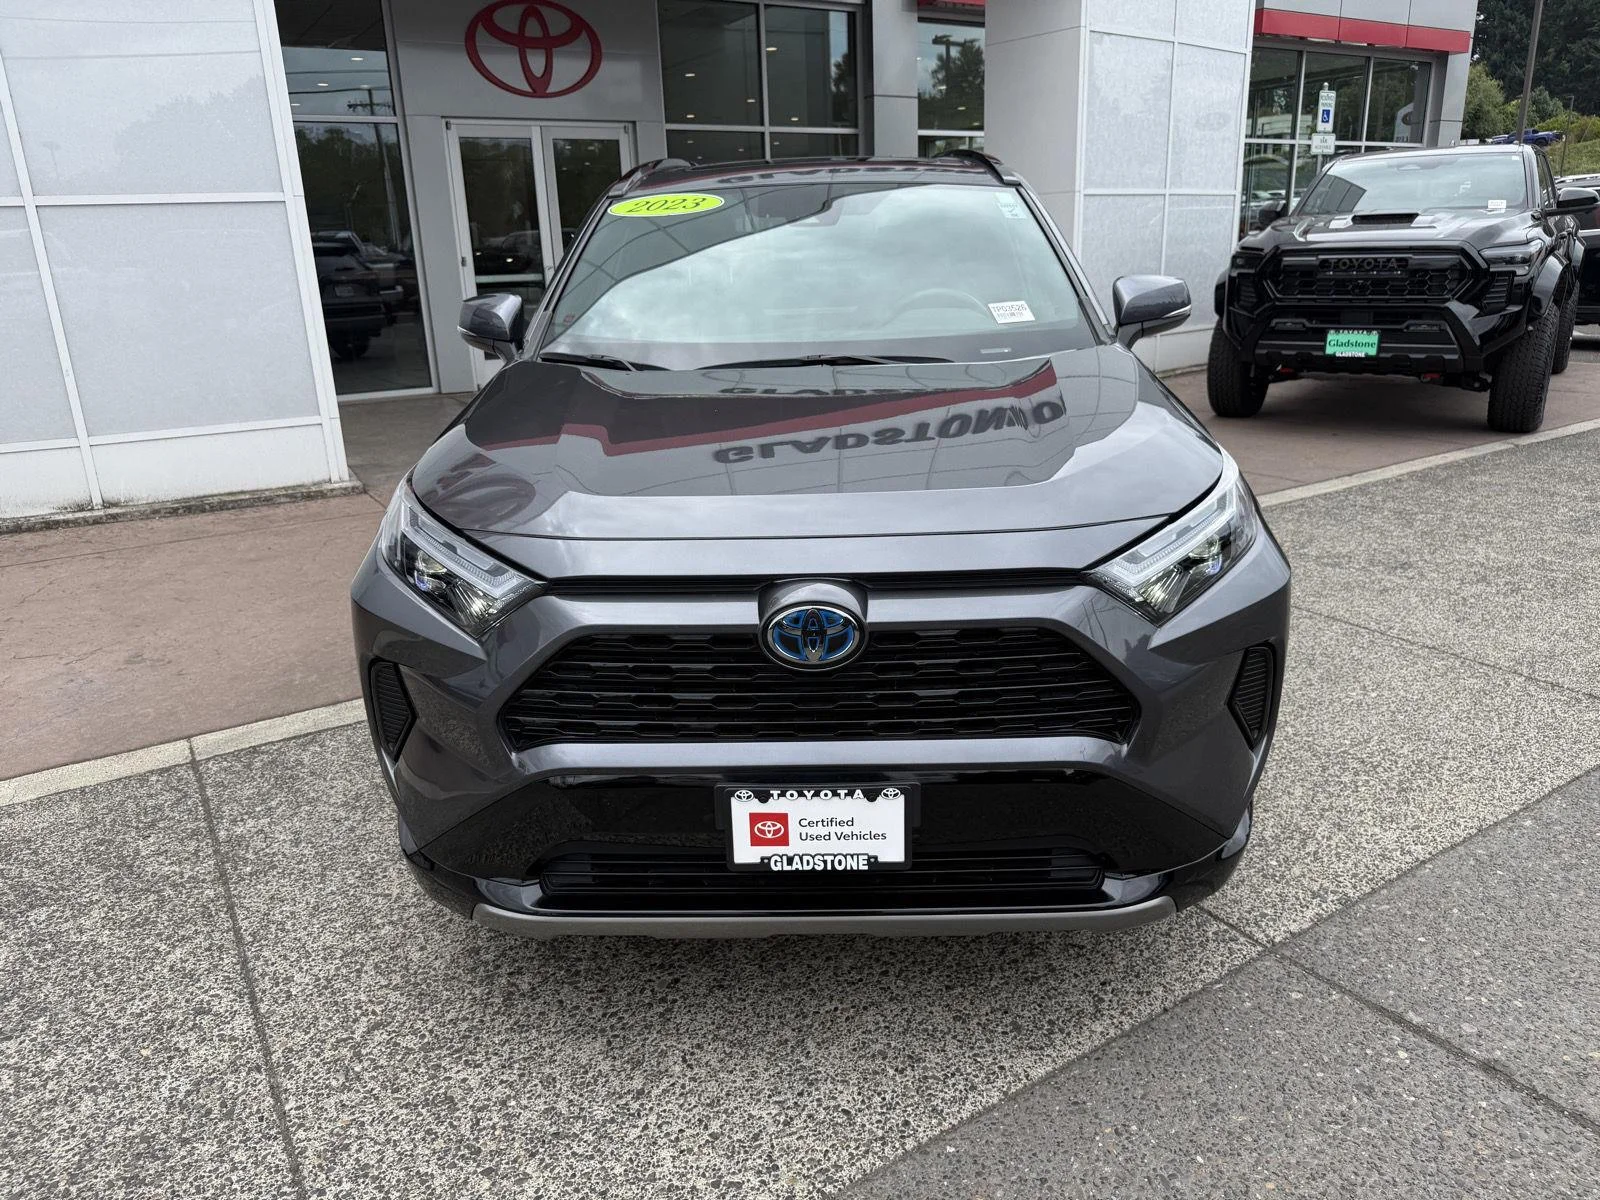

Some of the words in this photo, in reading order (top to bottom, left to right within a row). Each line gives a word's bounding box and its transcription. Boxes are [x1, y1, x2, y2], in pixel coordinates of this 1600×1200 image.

[626, 198, 707, 213] 2023
[1328, 258, 1398, 270] TOYOTA
[1328, 339, 1376, 348] Gladstone
[770, 789, 865, 800] TOYOTA
[798, 817, 854, 828] Certified
[799, 831, 831, 842] Used
[835, 830, 887, 842] Vehicles
[770, 854, 869, 871] GLADSTONE
